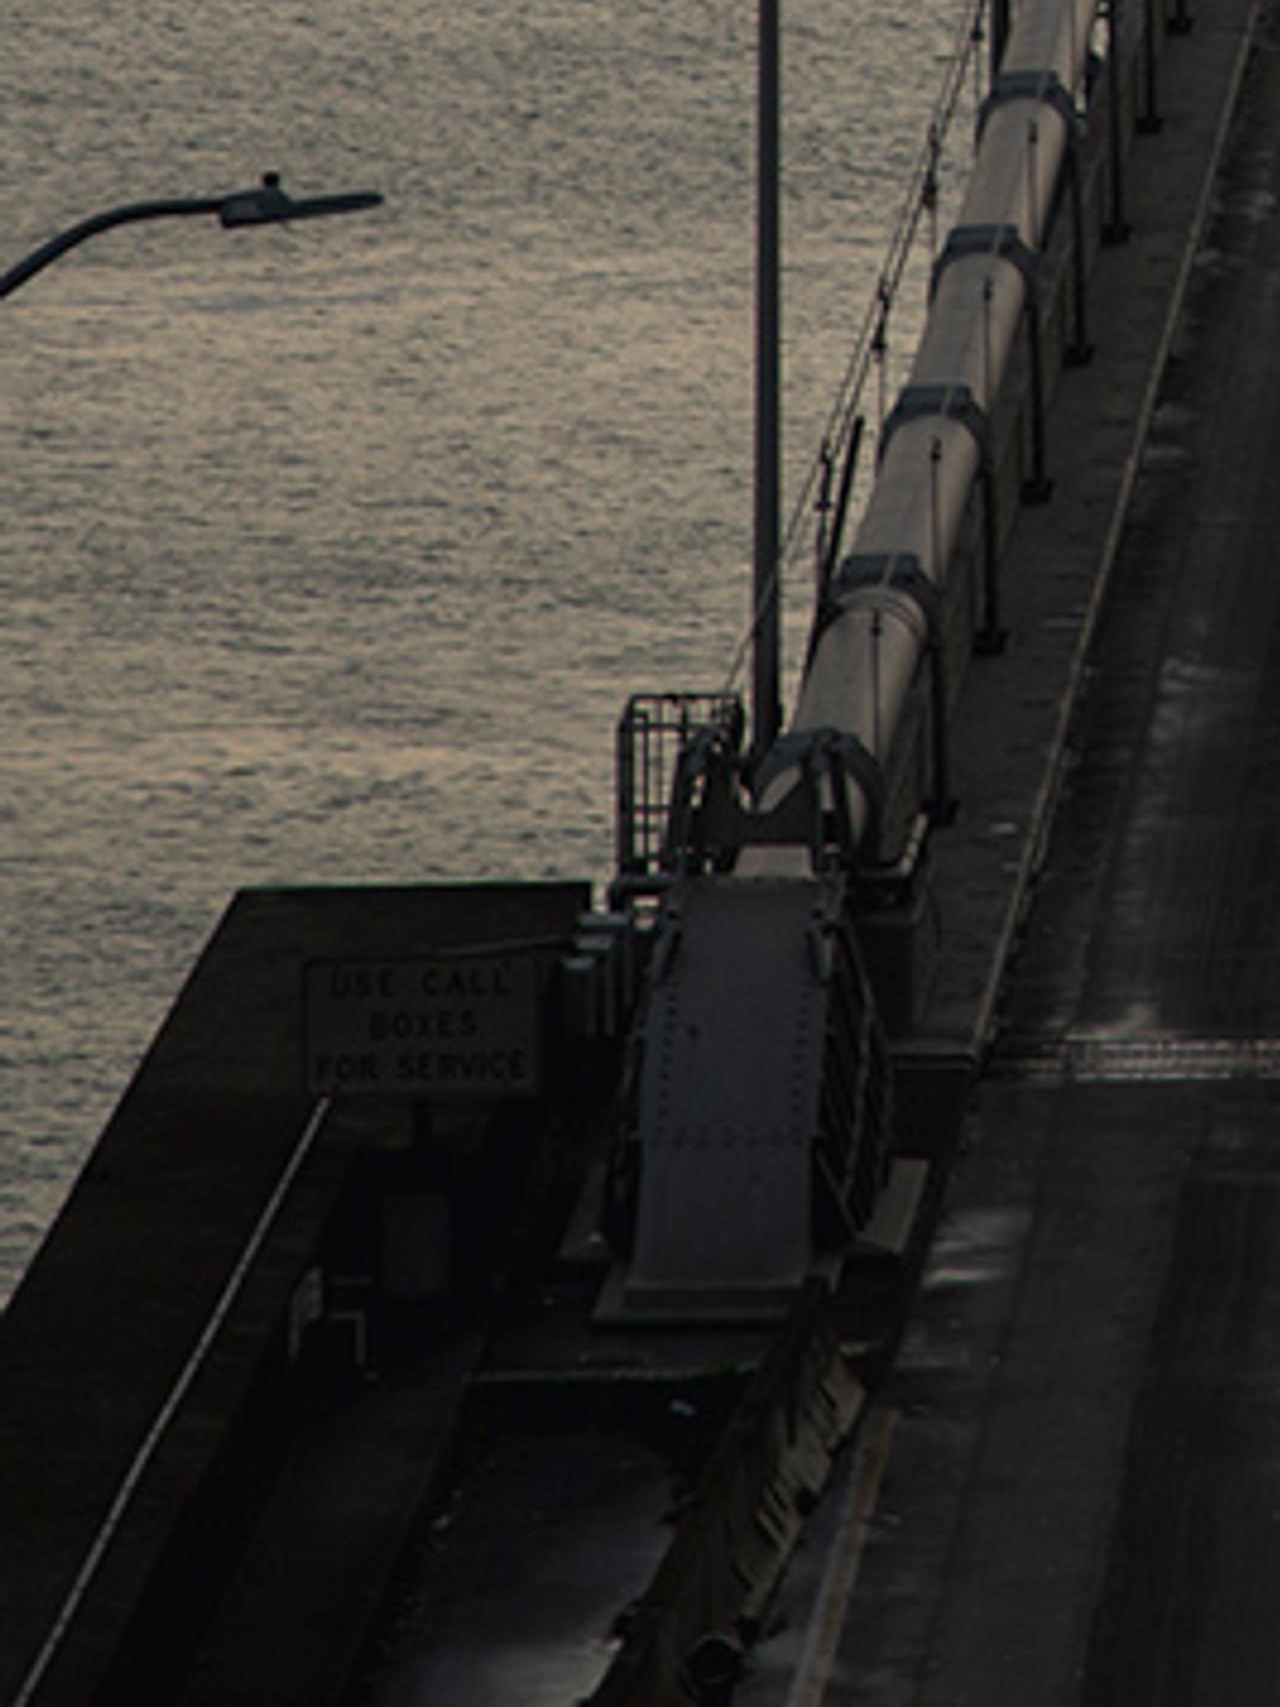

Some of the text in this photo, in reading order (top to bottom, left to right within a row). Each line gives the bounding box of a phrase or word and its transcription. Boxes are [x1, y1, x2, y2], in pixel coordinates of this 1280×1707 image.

[331, 967, 511, 998] USE CALL
[370, 1012, 476, 1040] BOXES
[315, 1051, 525, 1080] FOR SERVICE
